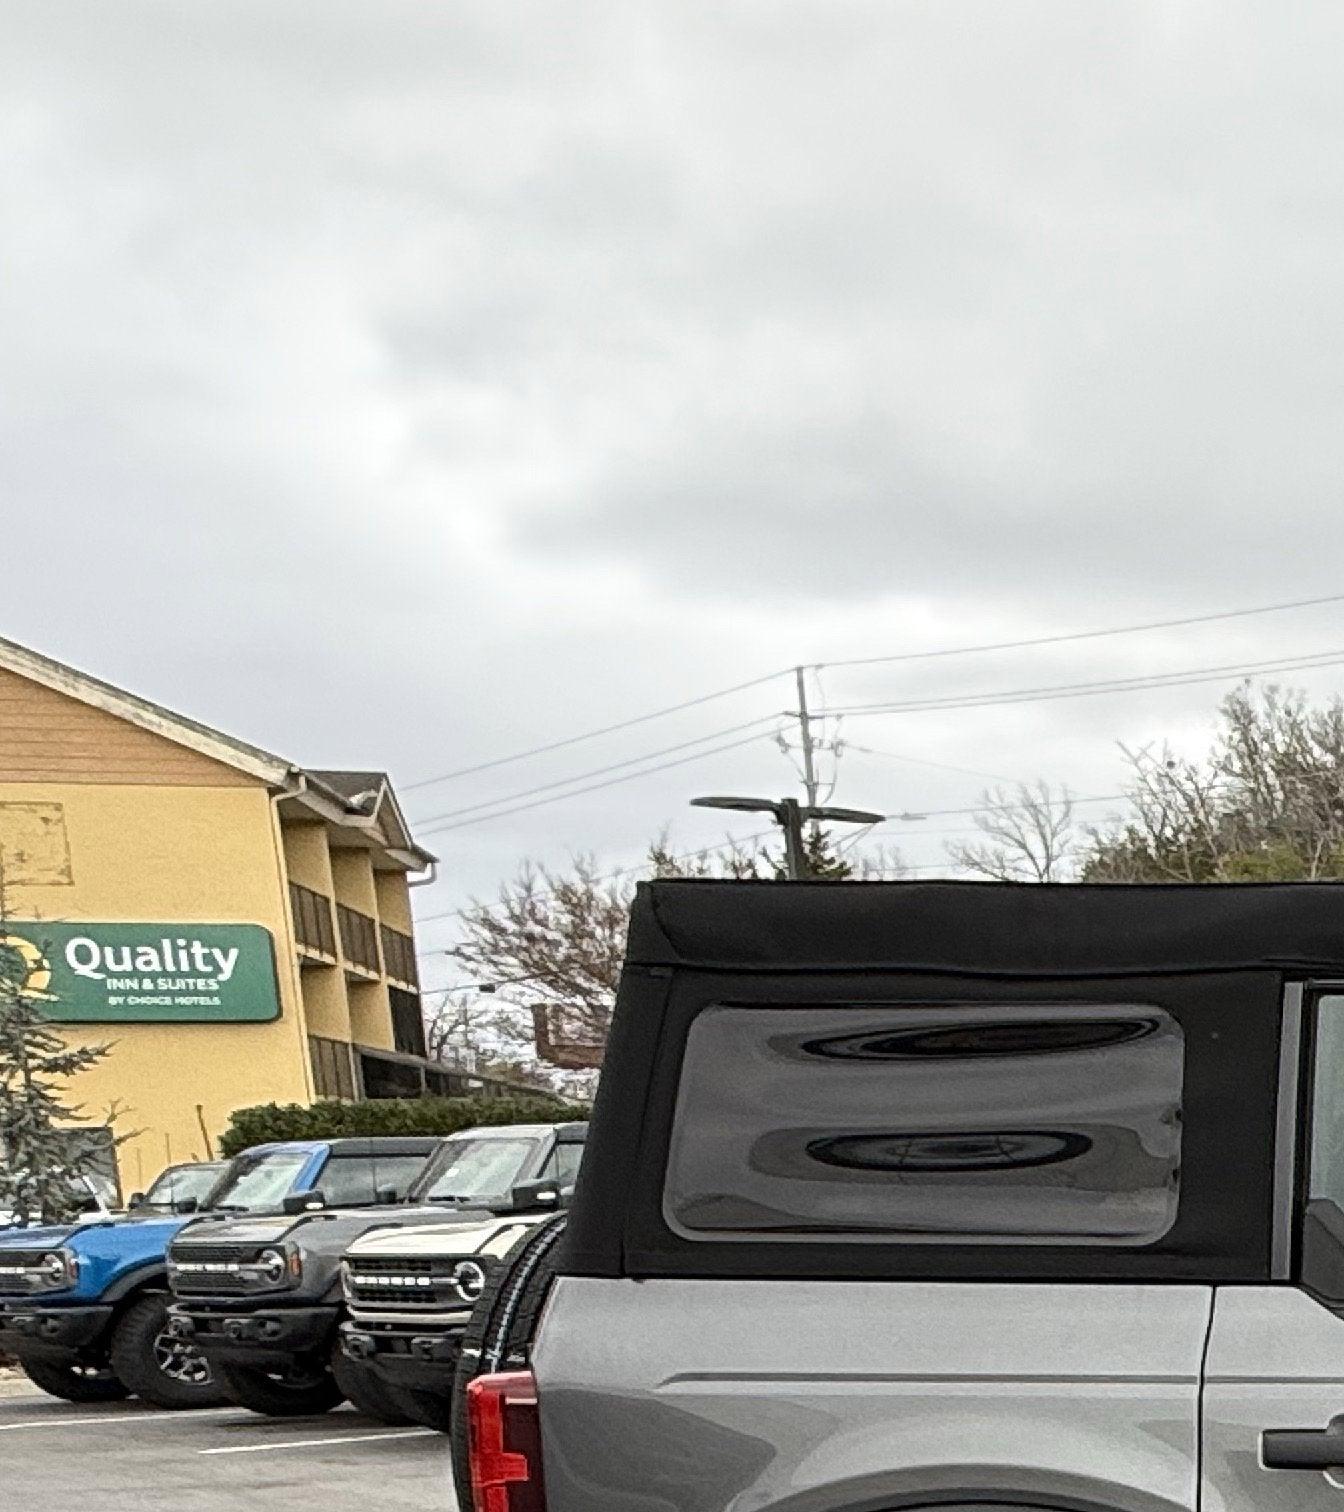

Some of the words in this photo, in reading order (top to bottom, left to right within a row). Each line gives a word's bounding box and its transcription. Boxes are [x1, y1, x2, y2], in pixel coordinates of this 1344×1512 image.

[65, 937, 239, 981] Quality
[106, 978, 139, 990] INN
[142, 978, 154, 990] &
[157, 978, 220, 990] SUITES
